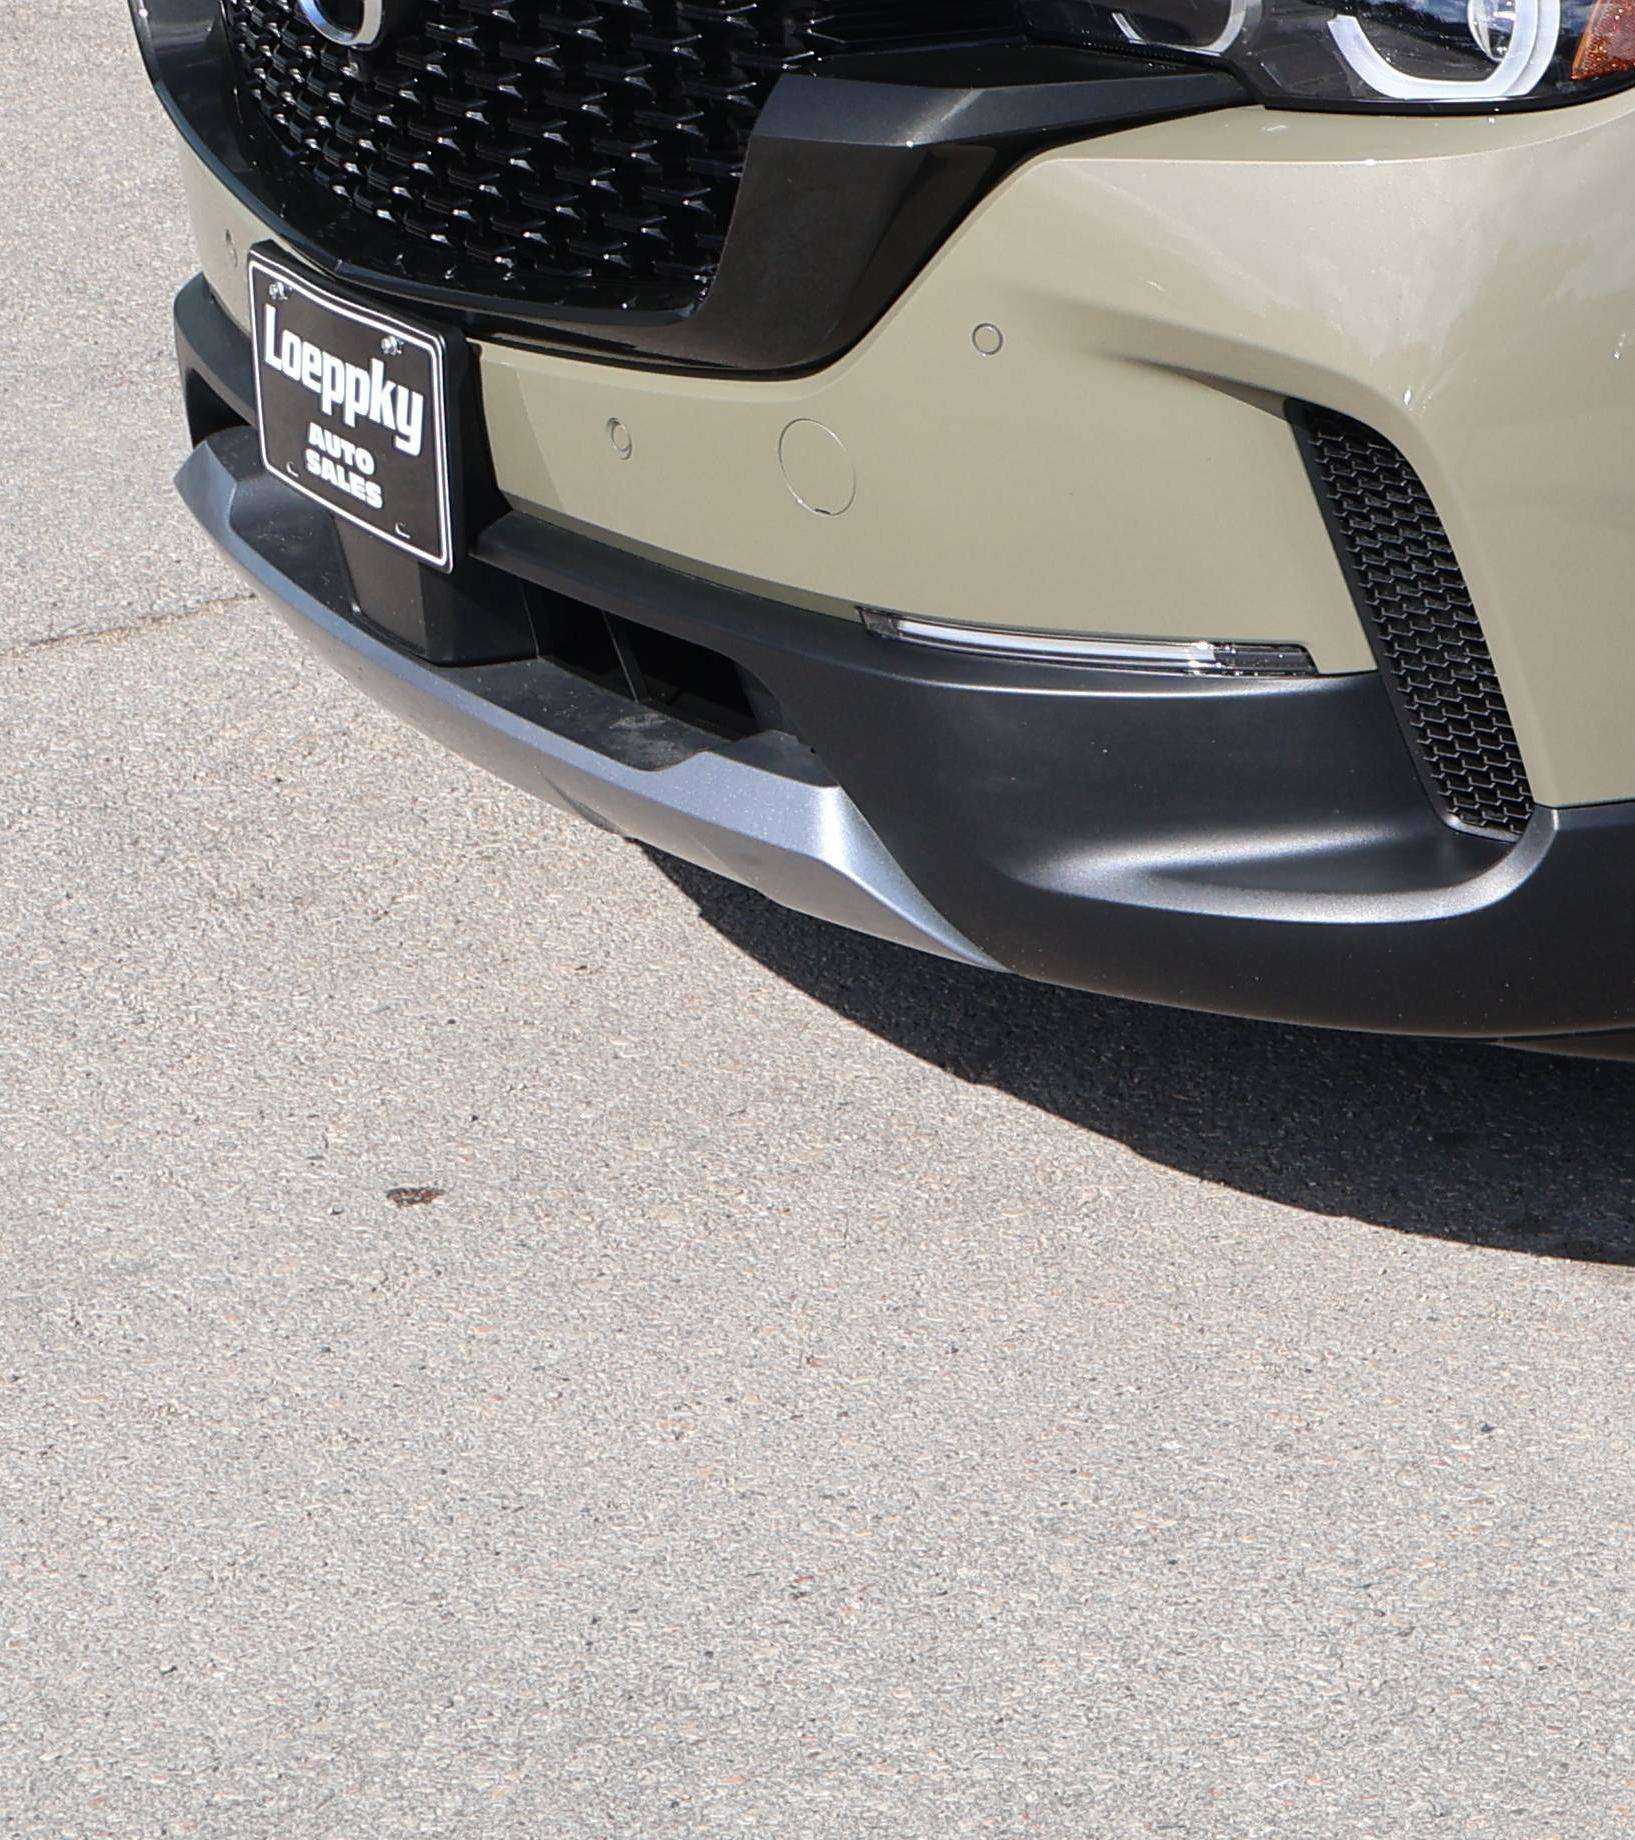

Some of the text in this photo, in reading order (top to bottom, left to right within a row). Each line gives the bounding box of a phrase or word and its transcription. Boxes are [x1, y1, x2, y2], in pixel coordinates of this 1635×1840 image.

[264, 304, 424, 457] Loeppky
[305, 448, 383, 510] SALES
[308, 422, 375, 477] AUTO
